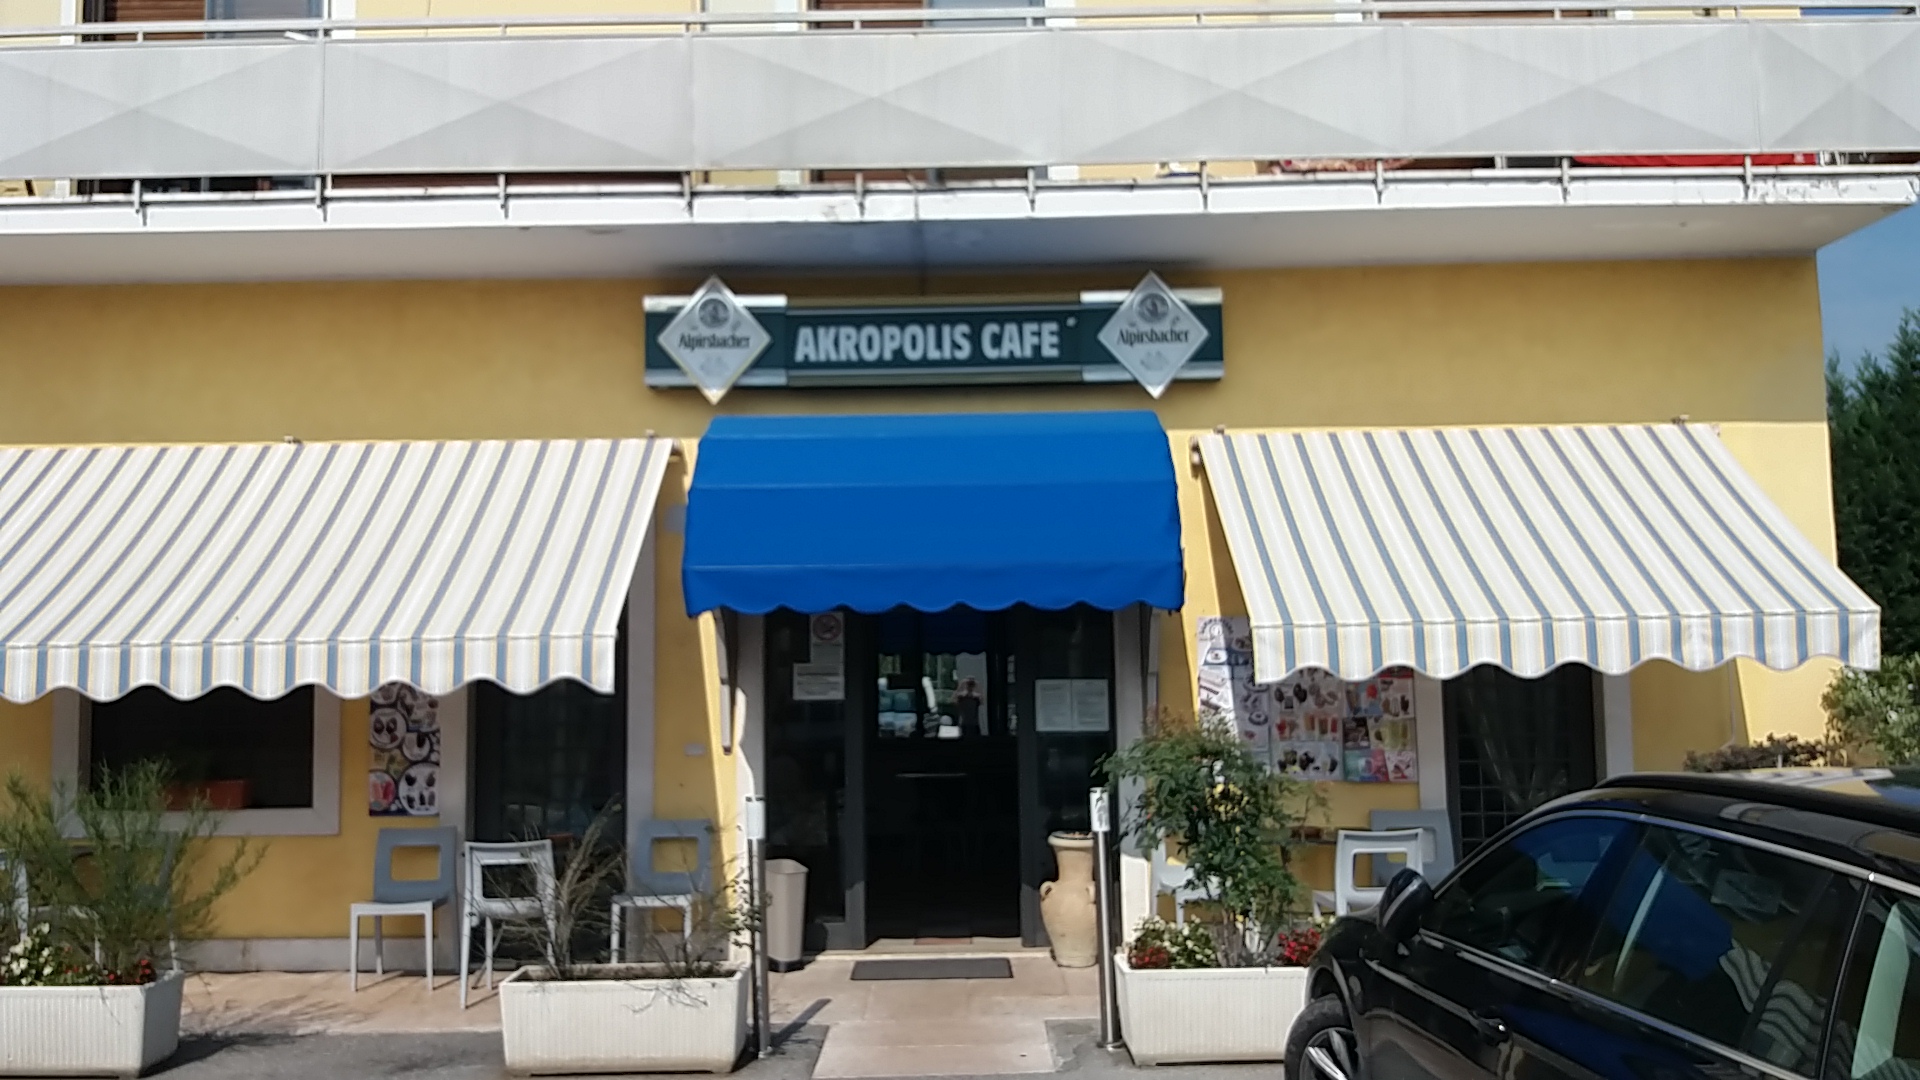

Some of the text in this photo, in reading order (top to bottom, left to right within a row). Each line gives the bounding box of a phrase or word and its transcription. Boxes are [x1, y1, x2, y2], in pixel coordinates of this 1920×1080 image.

[678, 332, 751, 352] Alpirsbacher
[794, 321, 1060, 363] AKROPOLIS CAFE
[1116, 327, 1189, 348] Alpirsbacher
